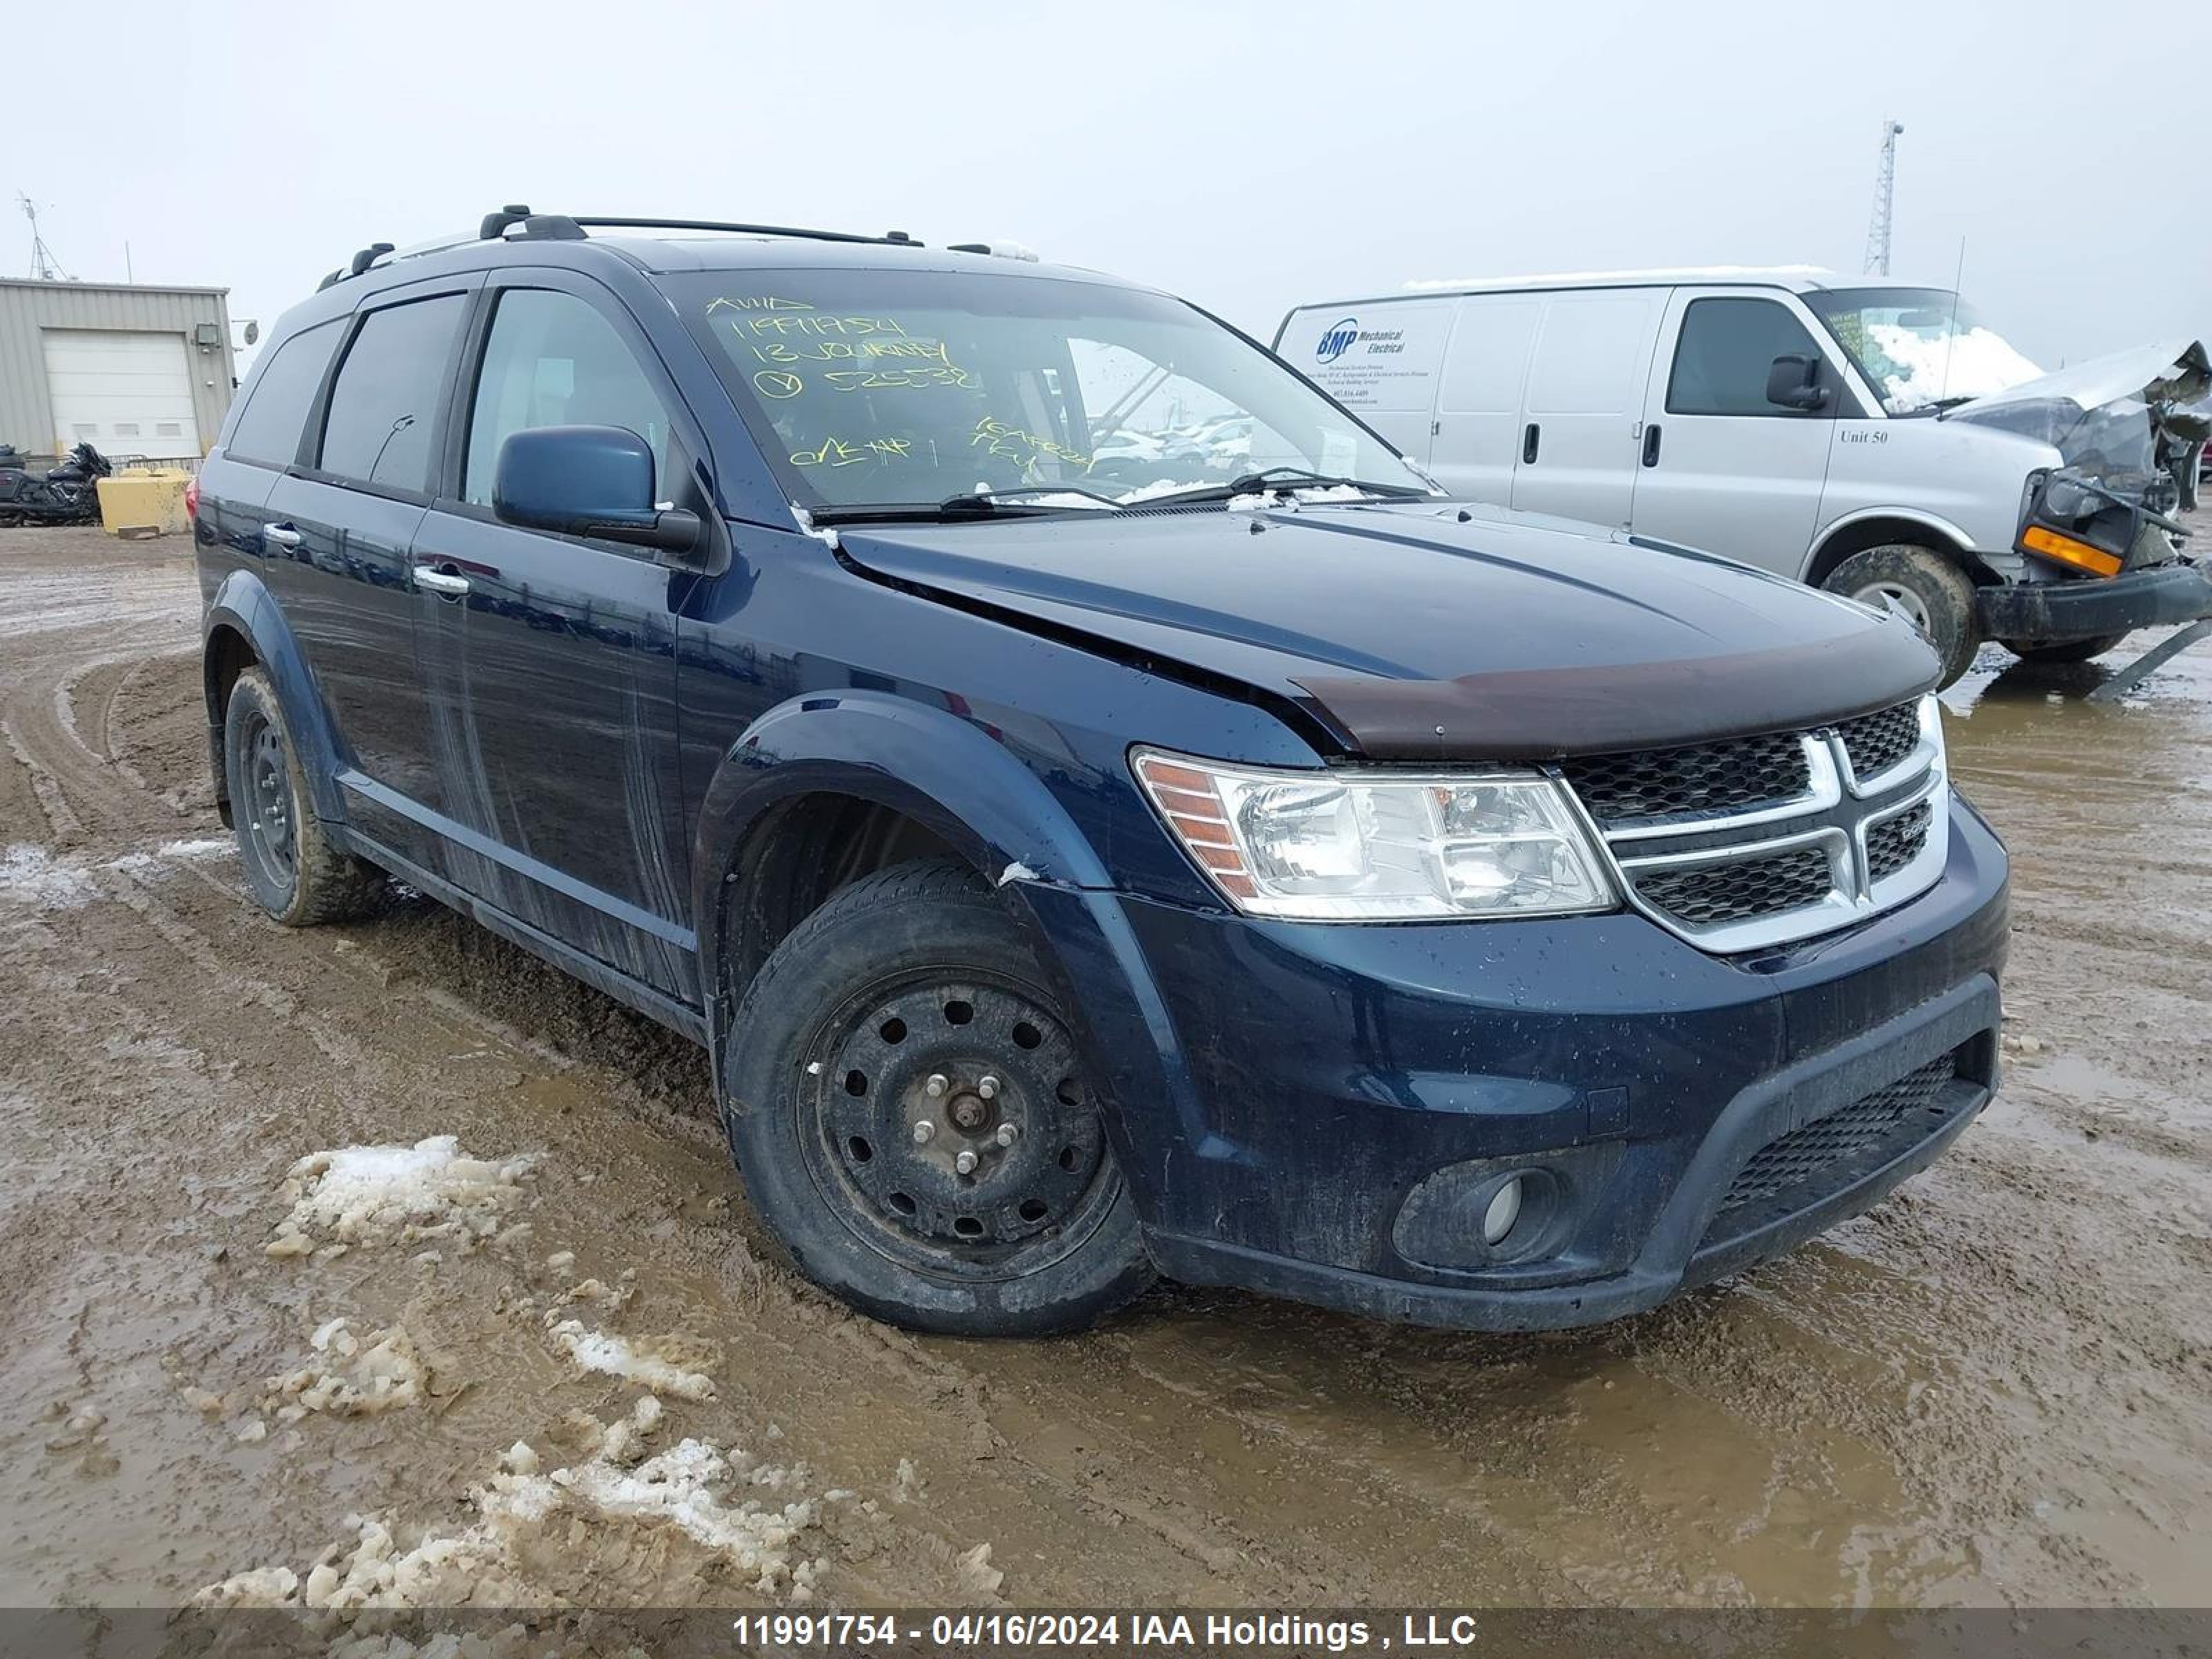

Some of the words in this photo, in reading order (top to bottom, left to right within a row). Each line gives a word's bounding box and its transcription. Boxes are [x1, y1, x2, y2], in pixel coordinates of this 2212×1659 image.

[1358, 329, 1404, 341] Mechanical
[1316, 330, 1358, 355] BMP
[1367, 343, 1405, 354] Electrical
[1841, 431, 1868, 443] Unit
[1872, 431, 1888, 443] 50
